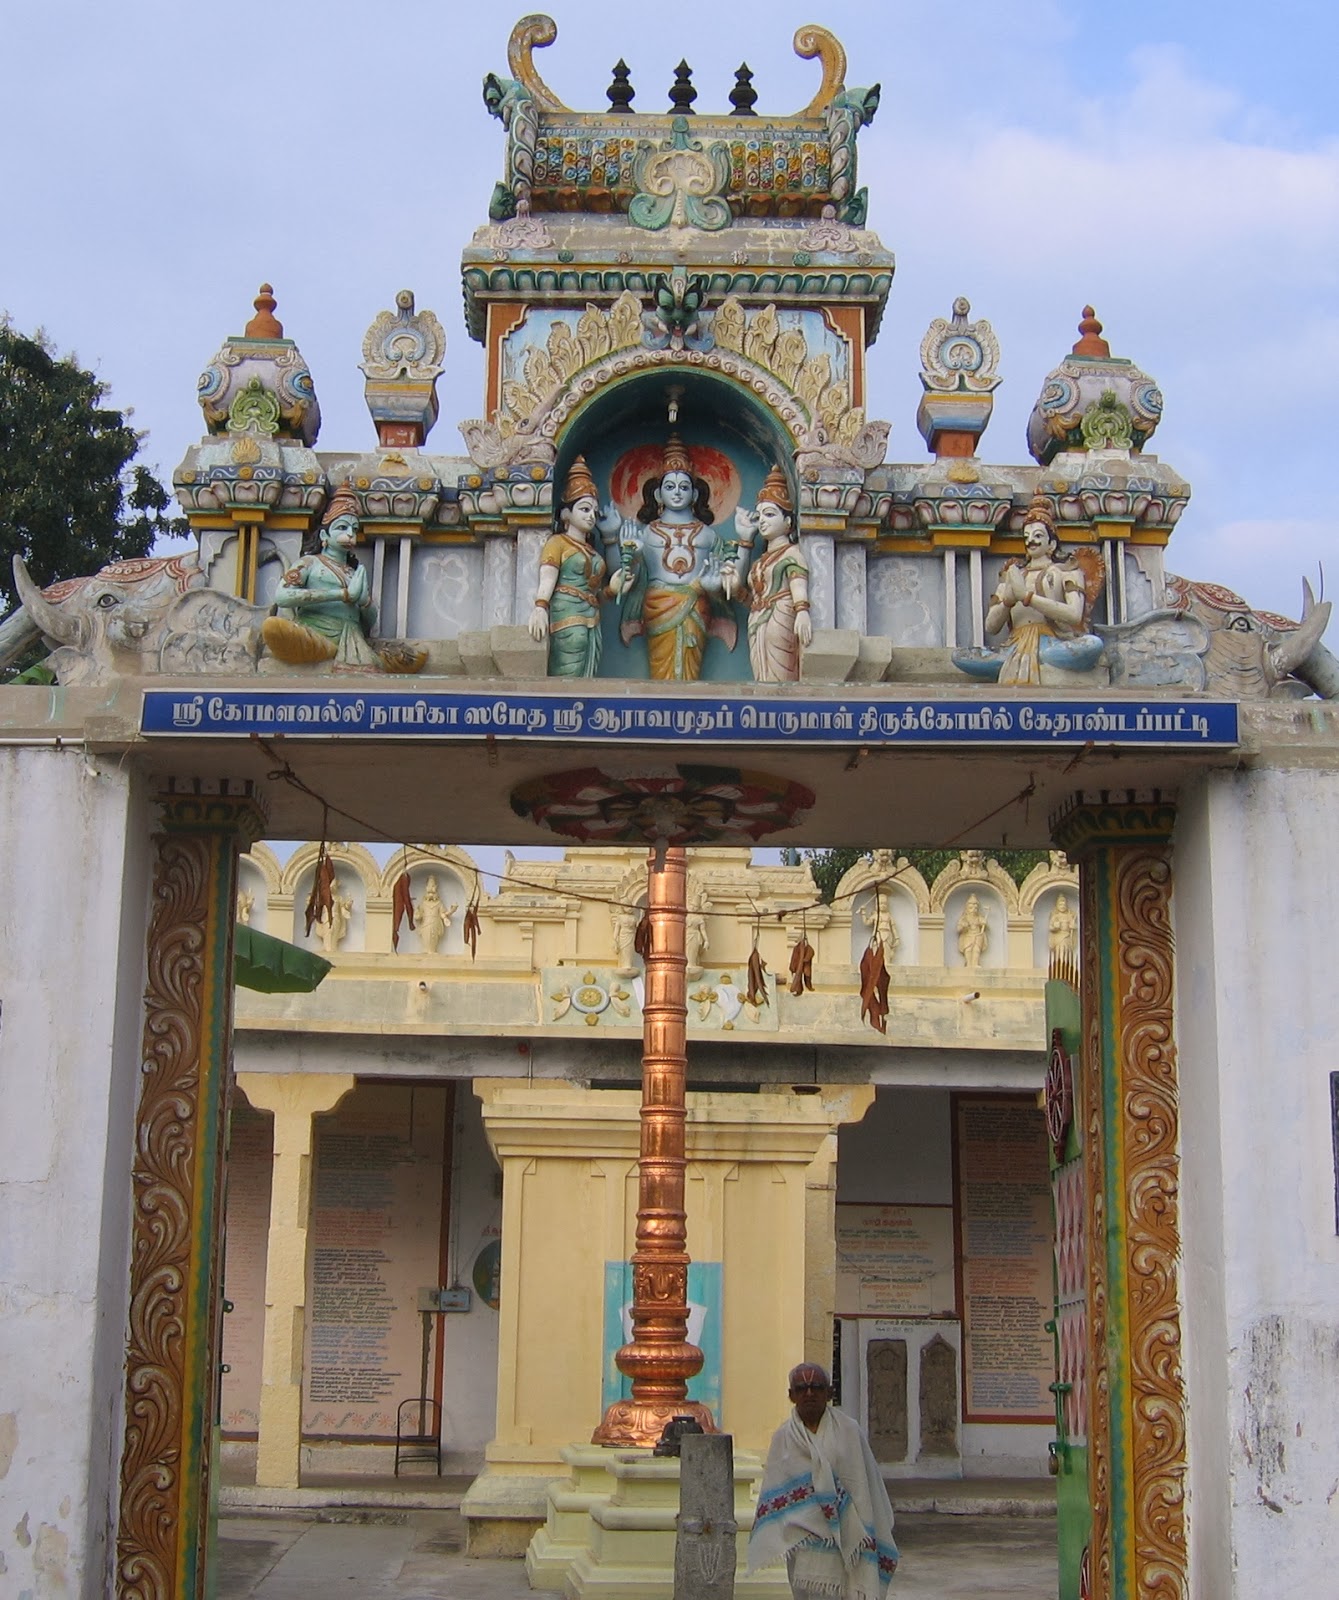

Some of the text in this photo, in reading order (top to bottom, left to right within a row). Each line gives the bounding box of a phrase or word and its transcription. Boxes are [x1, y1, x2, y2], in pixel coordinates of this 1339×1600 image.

[207, 696, 365, 723] கோமளவல்லி
[369, 699, 460, 729] நாயிகா
[464, 701, 547, 732] ஸமேத
[587, 704, 734, 735] ஆராவமுதப்
[739, 705, 854, 735] பெருமாள்
[858, 706, 1013, 736] திருக்கோயில்
[1018, 706, 1210, 738] கேதாண்டப்பட்டி
